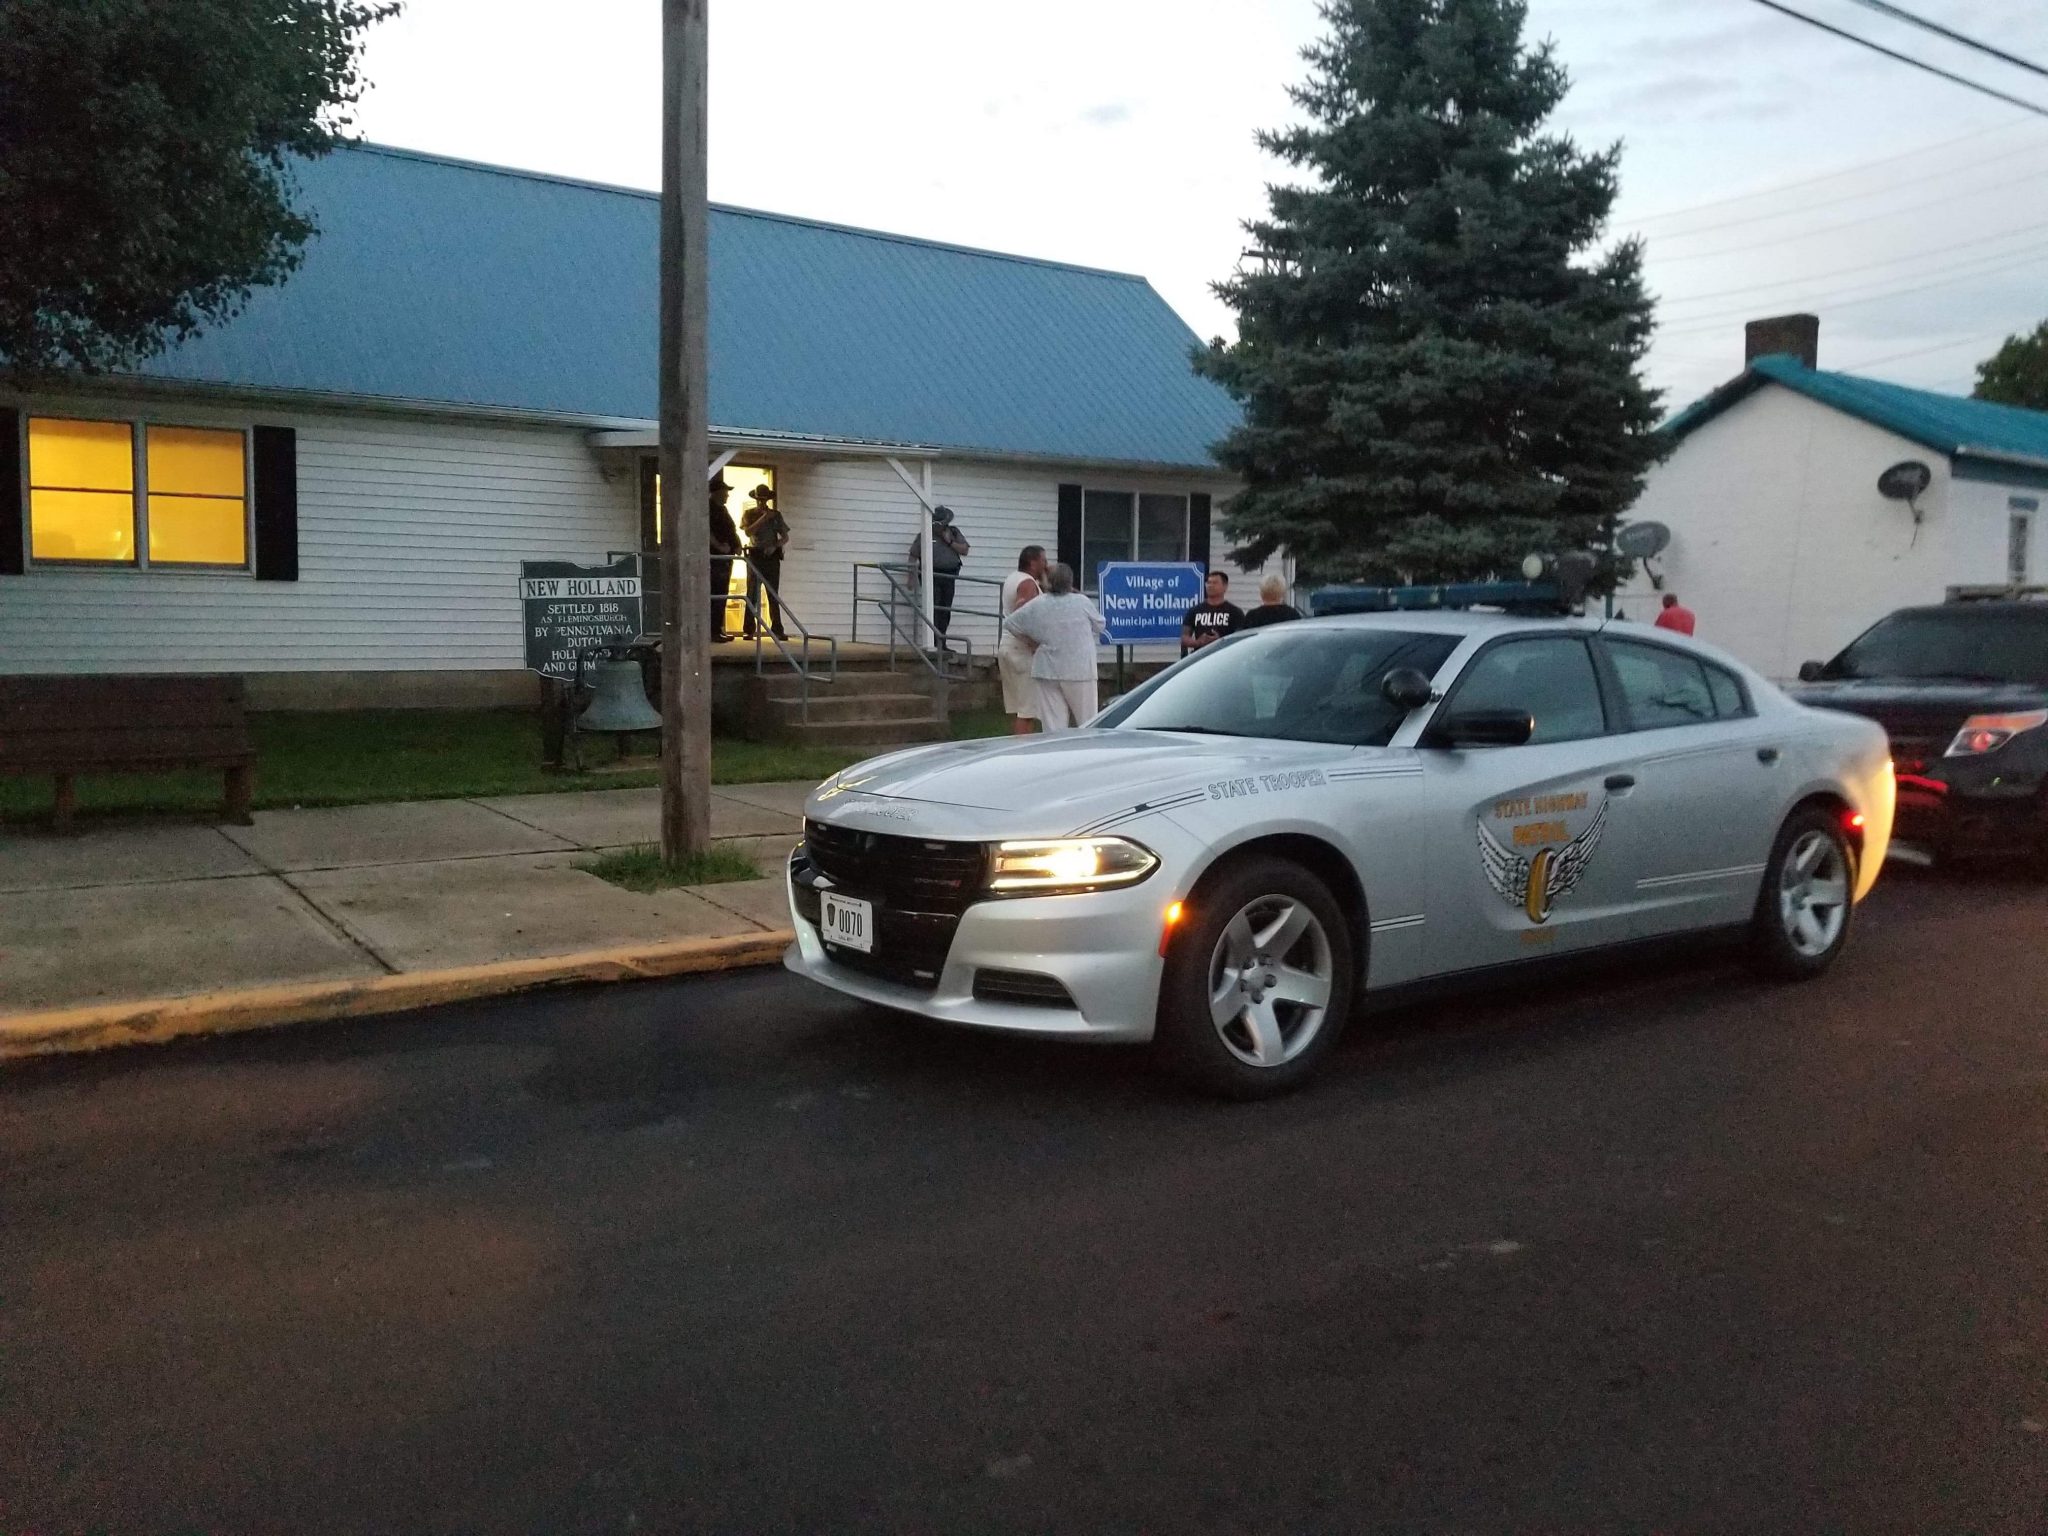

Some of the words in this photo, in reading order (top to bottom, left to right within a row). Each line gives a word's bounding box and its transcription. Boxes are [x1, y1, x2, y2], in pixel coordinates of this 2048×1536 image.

[526, 580, 560, 597] NEW
[568, 579, 636, 596] HOLLAND
[1126, 576, 1163, 590] Village
[1168, 576, 1179, 587] of
[1105, 594, 1138, 610] New
[1143, 593, 1198, 610] Holland
[547, 604, 595, 614] SETTLED
[600, 603, 619, 613] 1818
[541, 616, 553, 624] AS
[1111, 616, 1155, 627] Municipal
[1158, 616, 1184, 626] Buildi
[1194, 612, 1230, 626] POLICE
[535, 627, 549, 637] BY
[567, 637, 602, 647] DUTCH
[542, 661, 566, 672] AND
[1208, 777, 1259, 800] STATE
[1259, 768, 1327, 792] TROOPER
[839, 908, 863, 938] 0070
